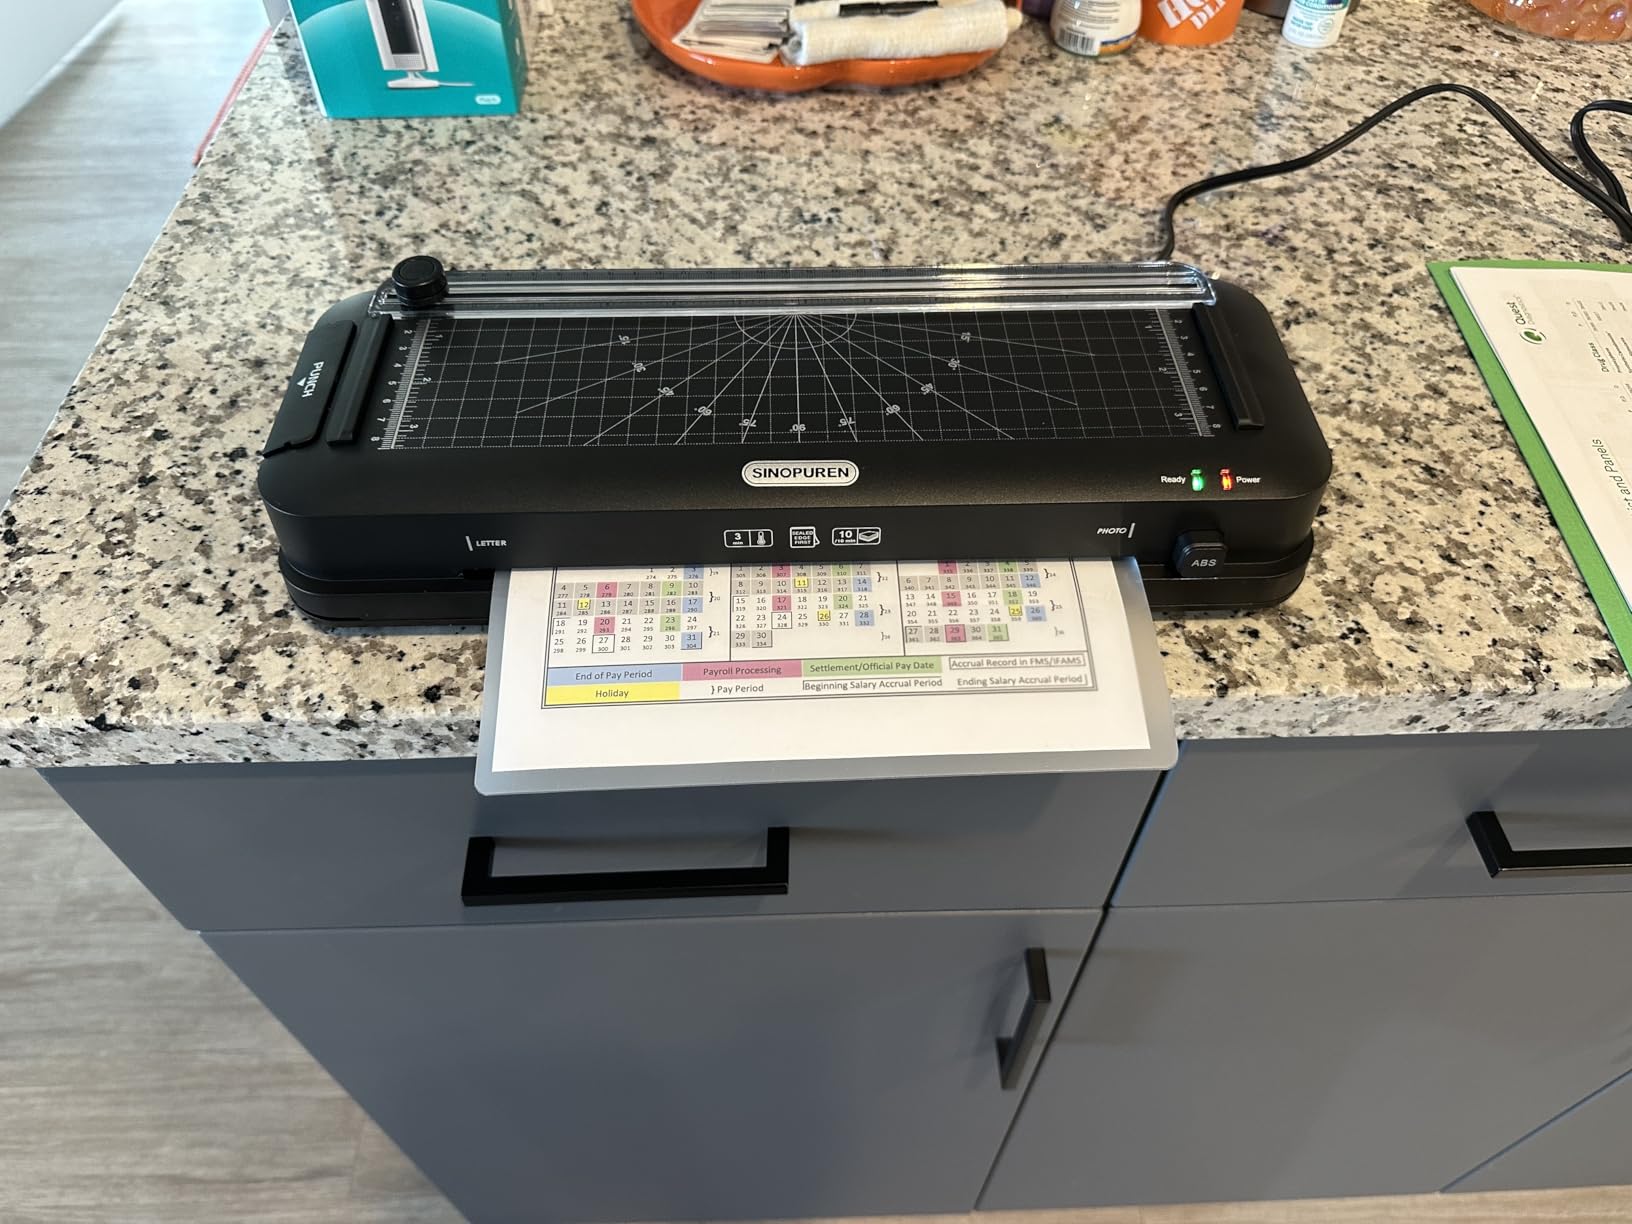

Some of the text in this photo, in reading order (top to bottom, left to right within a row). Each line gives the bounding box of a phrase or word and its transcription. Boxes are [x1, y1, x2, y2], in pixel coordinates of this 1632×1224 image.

[1506, 302, 1526, 325] Quest
[301, 361, 325, 398] PUNCH
[1592, 438, 1631, 495] and Panels
[752, 467, 849, 478] SINOPUREN
[1160, 475, 1186, 485] Ready
[1236, 475, 1261, 484] Power
[734, 532, 742, 540] 3
[838, 530, 852, 538] 10
[1096, 527, 1127, 535] PHOTO
[1190, 558, 1217, 567] ABS
[810, 662, 893, 672] Settlement/Official
[895, 663, 911, 671] Pay
[952, 659, 984, 668] Accrual
[986, 658, 1017, 666] Record
[575, 672, 592, 680] End
[606, 672, 622, 680] Pay
[624, 670, 652, 679] Period
[703, 666, 782, 676] Payroll Processing
[805, 679, 943, 692] Beginning Salary Accrual Period
[957, 674, 1082, 687] Ending Salary Accrual Period
[717, 684, 764, 694] Pay Period
[595, 690, 629, 699] Holiday
